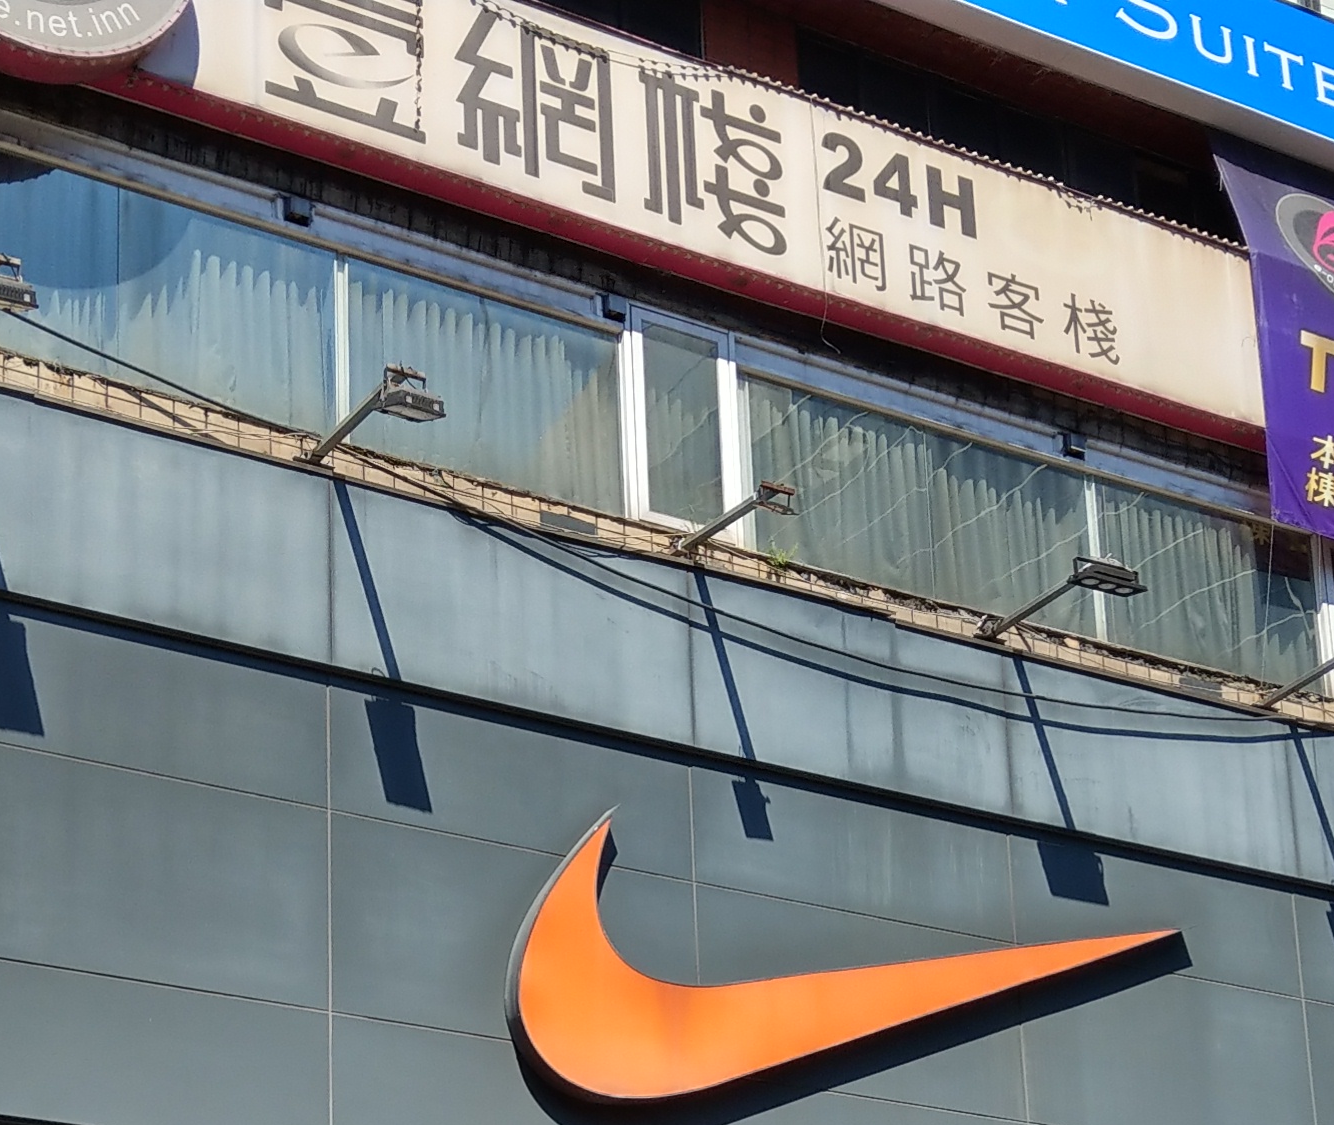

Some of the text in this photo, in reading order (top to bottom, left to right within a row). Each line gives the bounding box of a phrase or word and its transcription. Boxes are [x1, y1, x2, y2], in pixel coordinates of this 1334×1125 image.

[822, 132, 977, 239] 24H
[827, 217, 1121, 366] 網路客棧
